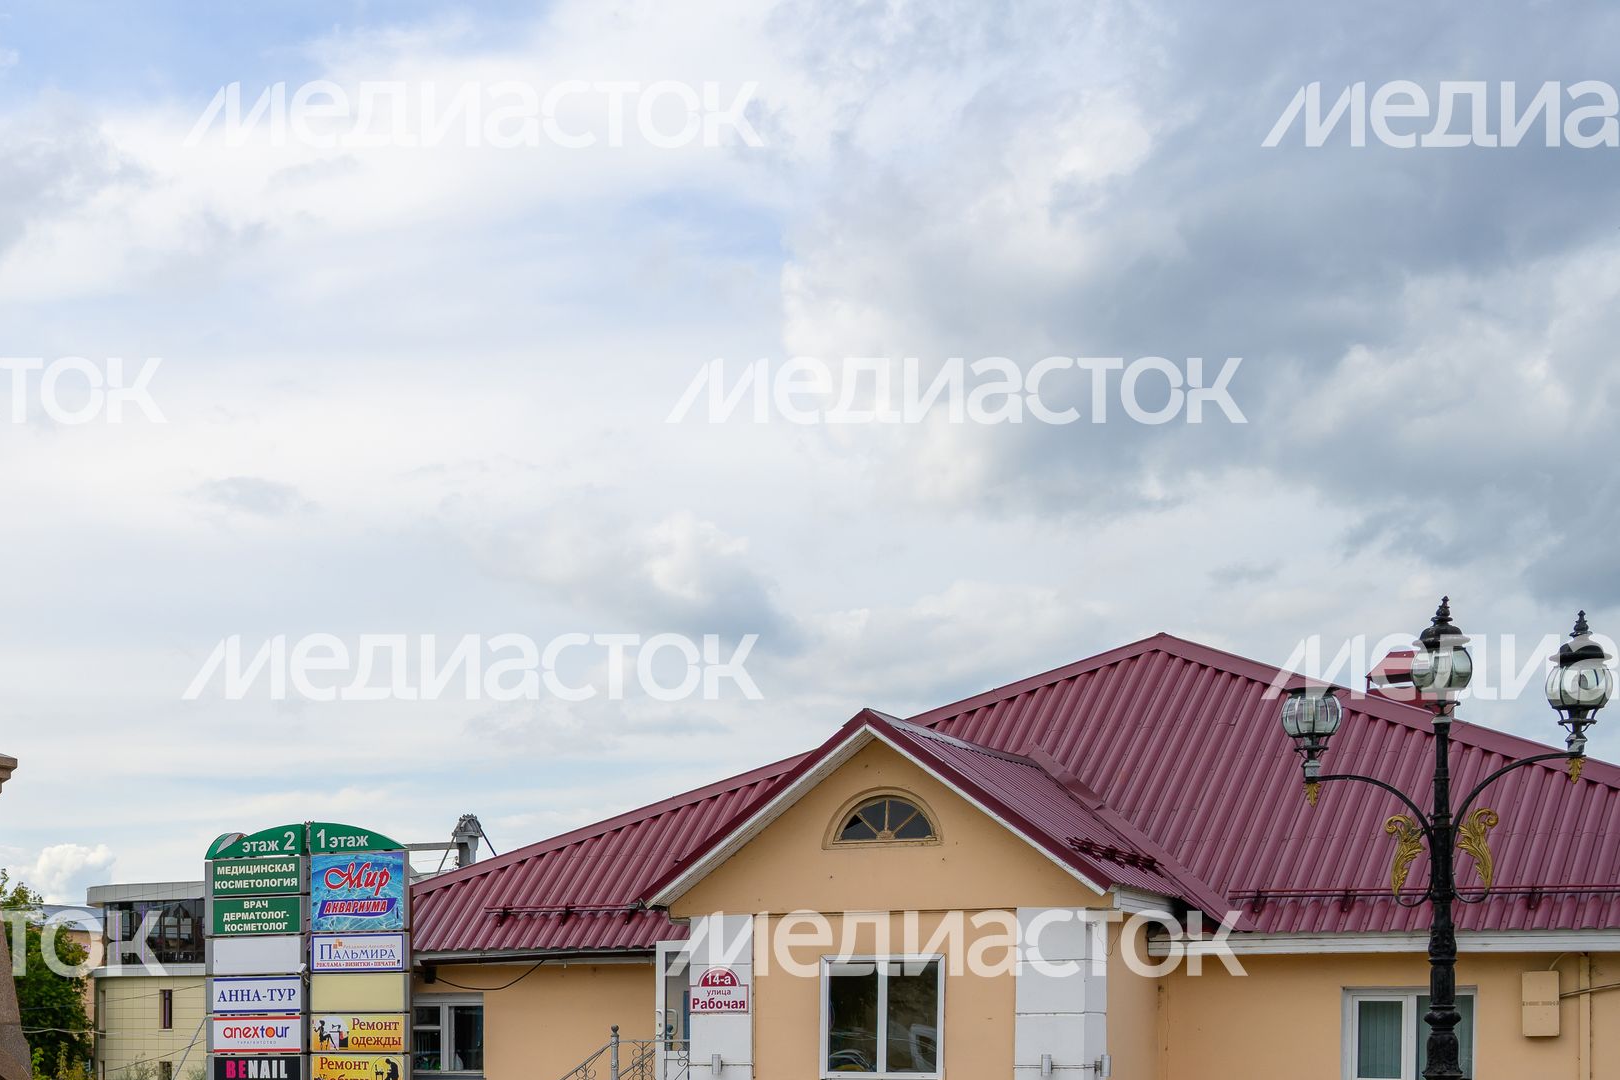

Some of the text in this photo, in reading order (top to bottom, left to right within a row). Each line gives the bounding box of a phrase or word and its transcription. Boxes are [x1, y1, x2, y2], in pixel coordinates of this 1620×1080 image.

[242, 831, 295, 853] этаж 2
[316, 829, 369, 849] 1 этаж
[216, 863, 296, 875] МЕДИЦИНСКАЯ
[214, 878, 298, 890] КОСМЕТОЛОГИЯ
[323, 861, 391, 896] Мир
[243, 900, 268, 909] ВРАЧ
[324, 899, 388, 914] АКВАРИУМА
[222, 911, 290, 922] ДЕРМАТОЛОГ-
[224, 921, 288, 931] КОСМЕТОЛОГ
[706, 973, 732, 985] 14-а
[217, 988, 296, 1003] АННА-ТУР
[706, 989, 732, 997] улица
[692, 997, 746, 1010] Рабочая
[352, 1018, 400, 1031] Ремонт
[223, 1025, 290, 1039] anextour
[352, 1034, 401, 1048] одежды
[320, 1057, 369, 1071] Ремонт
